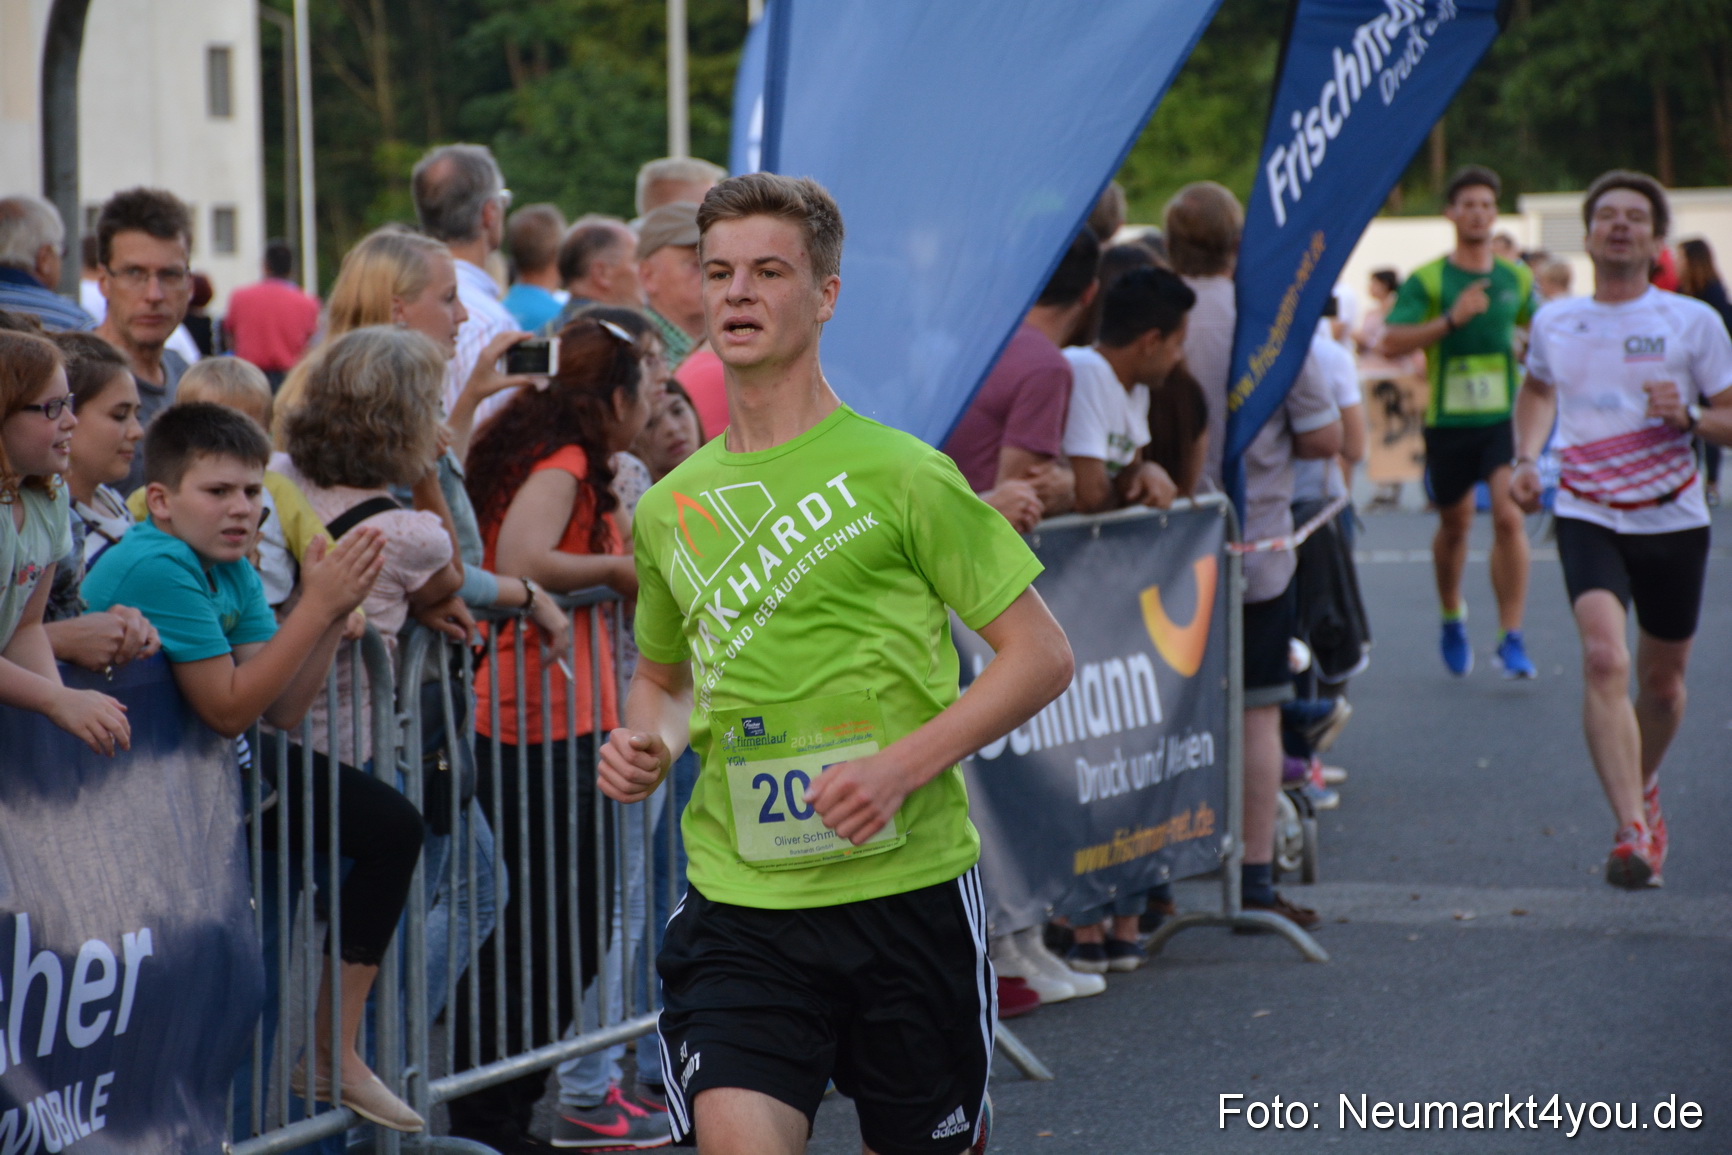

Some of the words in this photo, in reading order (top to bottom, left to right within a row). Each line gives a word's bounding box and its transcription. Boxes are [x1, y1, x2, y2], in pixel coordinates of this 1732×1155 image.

[1379, 24, 1429, 107] Druck
[1266, 0, 1426, 228] Frischma
[725, 625, 754, 659] UND
[753, 511, 879, 628] GEBÄUDETECHNIK
[737, 731, 787, 748] firmenlauf
[791, 733, 823, 748] 2016
[1075, 747, 1130, 804] Druck
[1130, 735, 1166, 790] und
[752, 761, 848, 824] 20
[774, 835, 801, 847] Oliver
[803, 830, 838, 844] Schm
[932, 1120, 970, 1139] adidas
